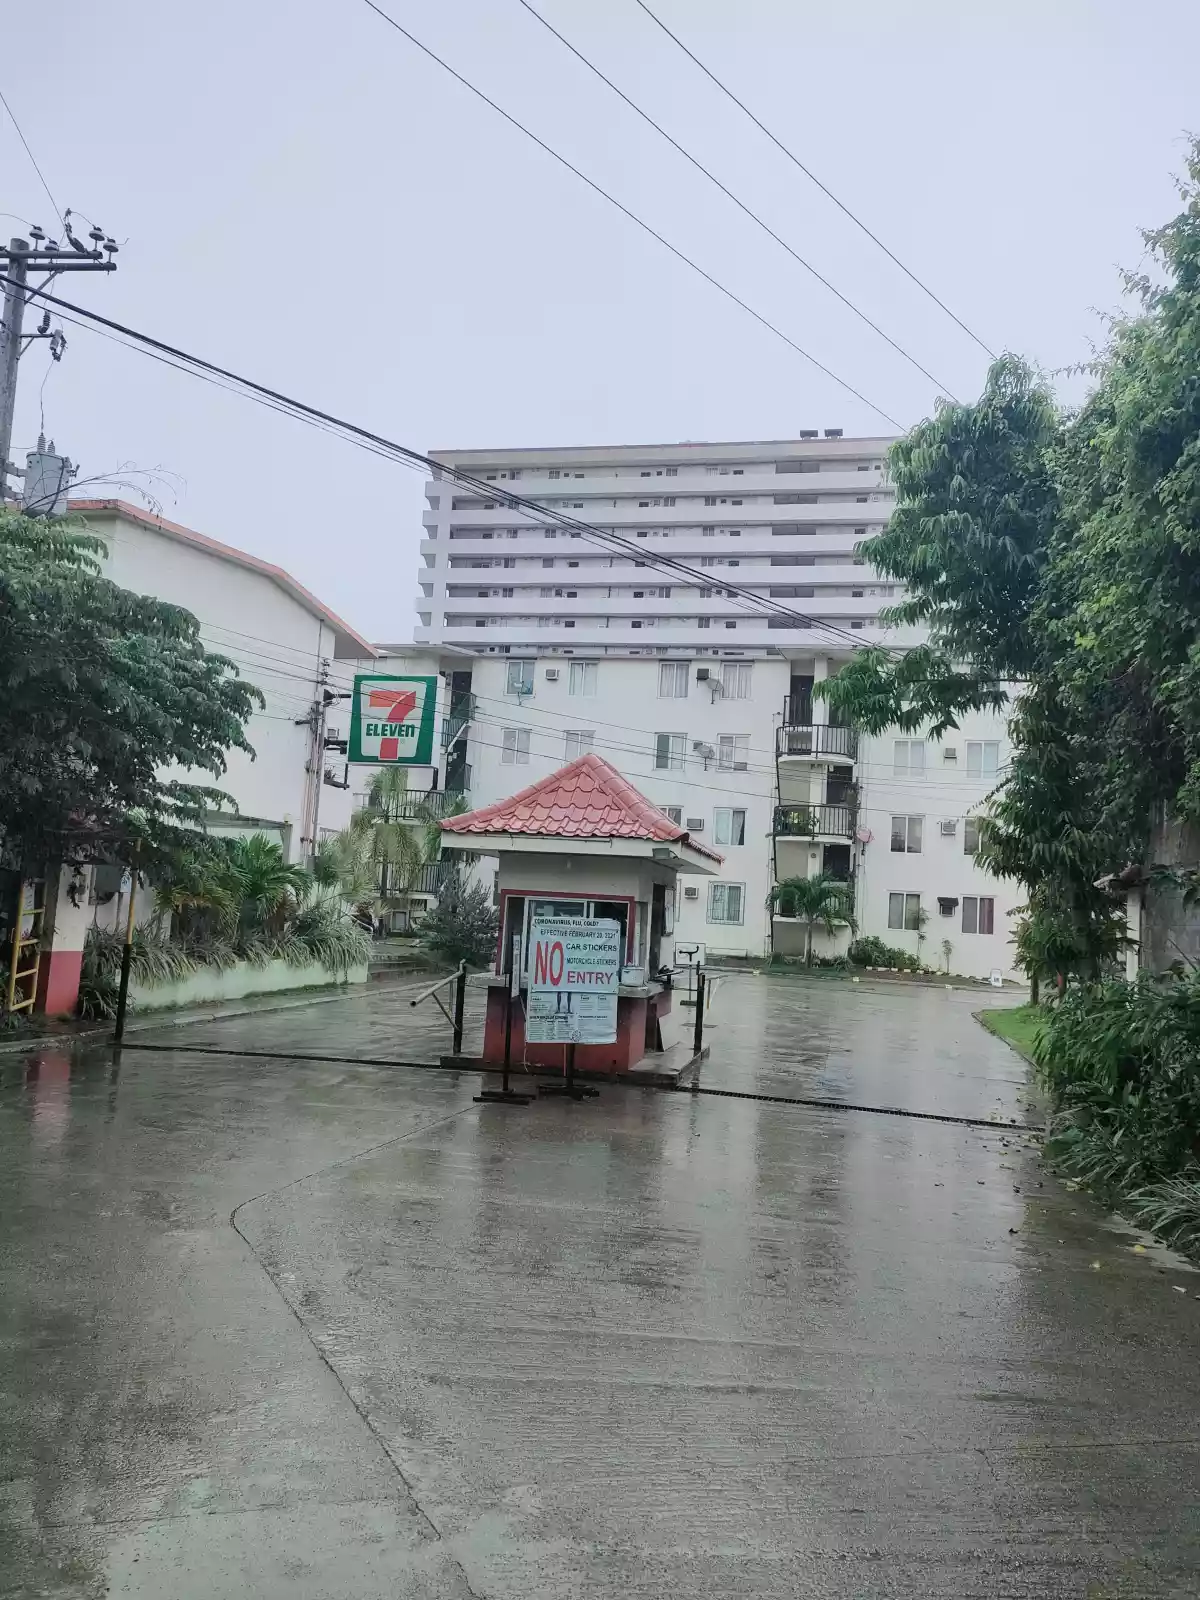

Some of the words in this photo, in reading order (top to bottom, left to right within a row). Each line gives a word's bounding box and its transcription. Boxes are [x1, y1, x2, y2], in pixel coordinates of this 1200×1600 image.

[369, 690, 416, 759] 7
[534, 918, 572, 926] CORONAVIRUS,
[534, 941, 564, 986] NO
[568, 971, 613, 984] ENTRY
